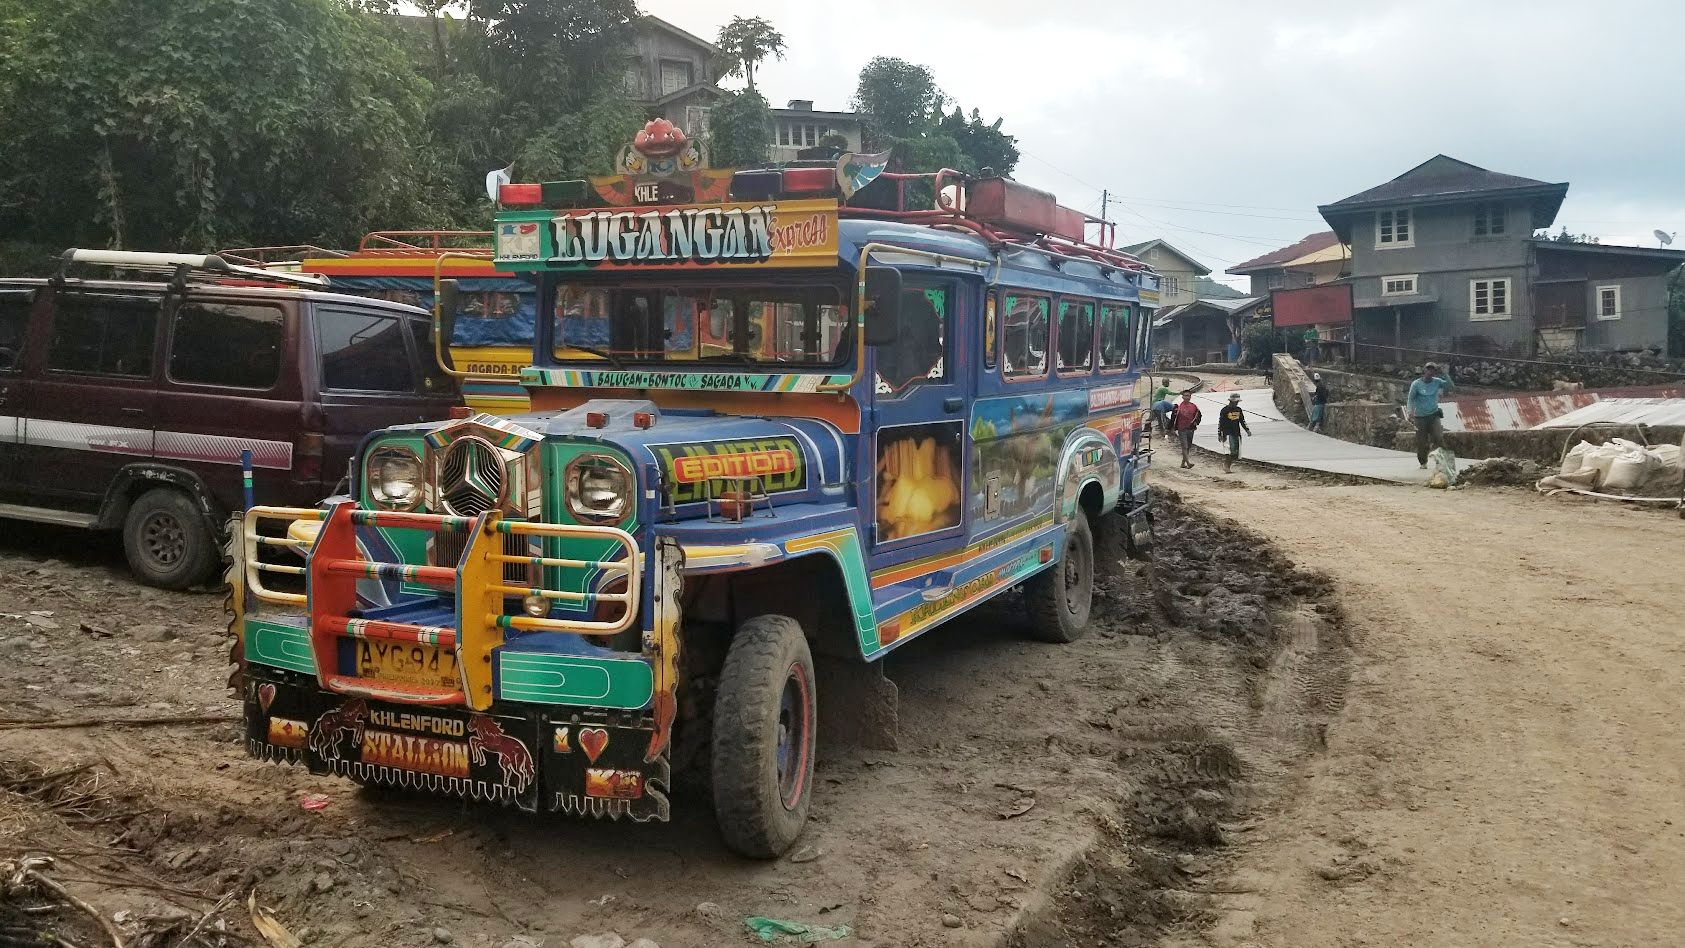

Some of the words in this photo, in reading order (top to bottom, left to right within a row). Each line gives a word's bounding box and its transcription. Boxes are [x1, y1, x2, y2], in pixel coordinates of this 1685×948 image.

[701, 374, 741, 389] SAGADA
[682, 453, 790, 479] EDITION
[370, 709, 465, 737] KHLENFORD
